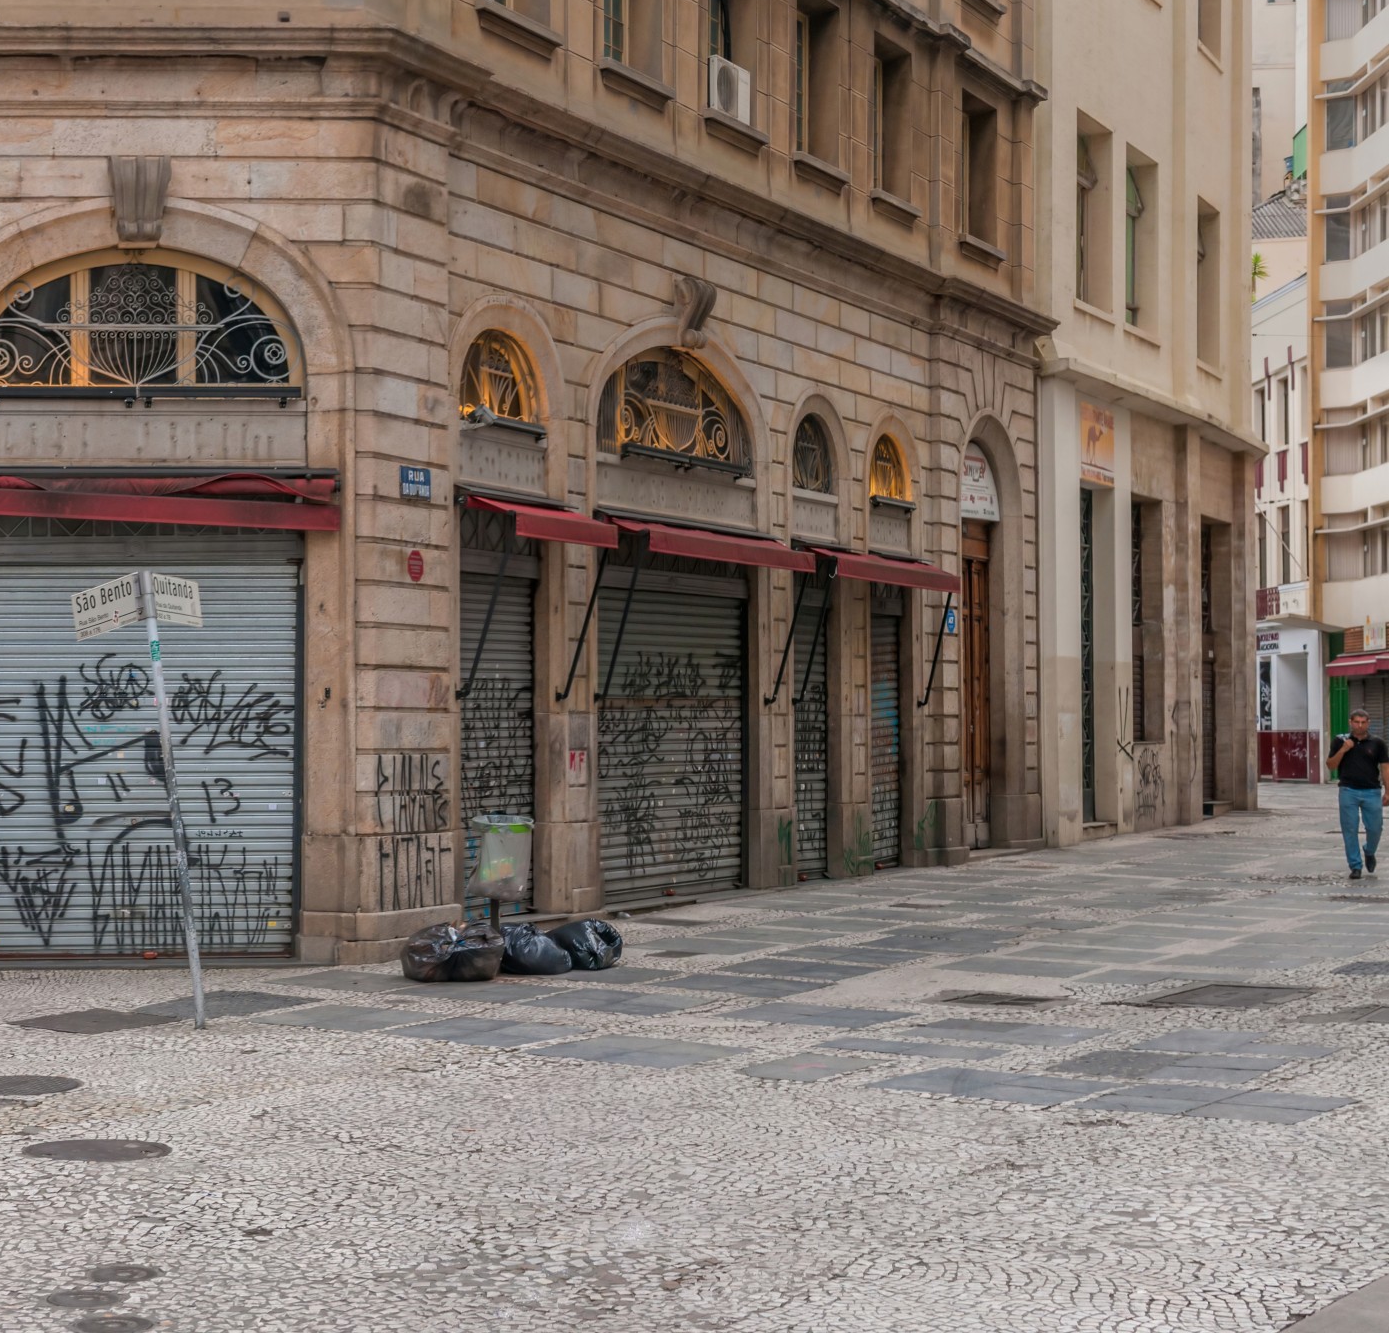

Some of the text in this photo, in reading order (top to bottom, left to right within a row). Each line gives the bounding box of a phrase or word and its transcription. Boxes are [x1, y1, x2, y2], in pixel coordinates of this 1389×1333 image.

[408, 470, 425, 482] RUA
[75, 580, 132, 614] São Bento
[153, 576, 193, 600] Quitanda
[88, 615, 97, 624] São
